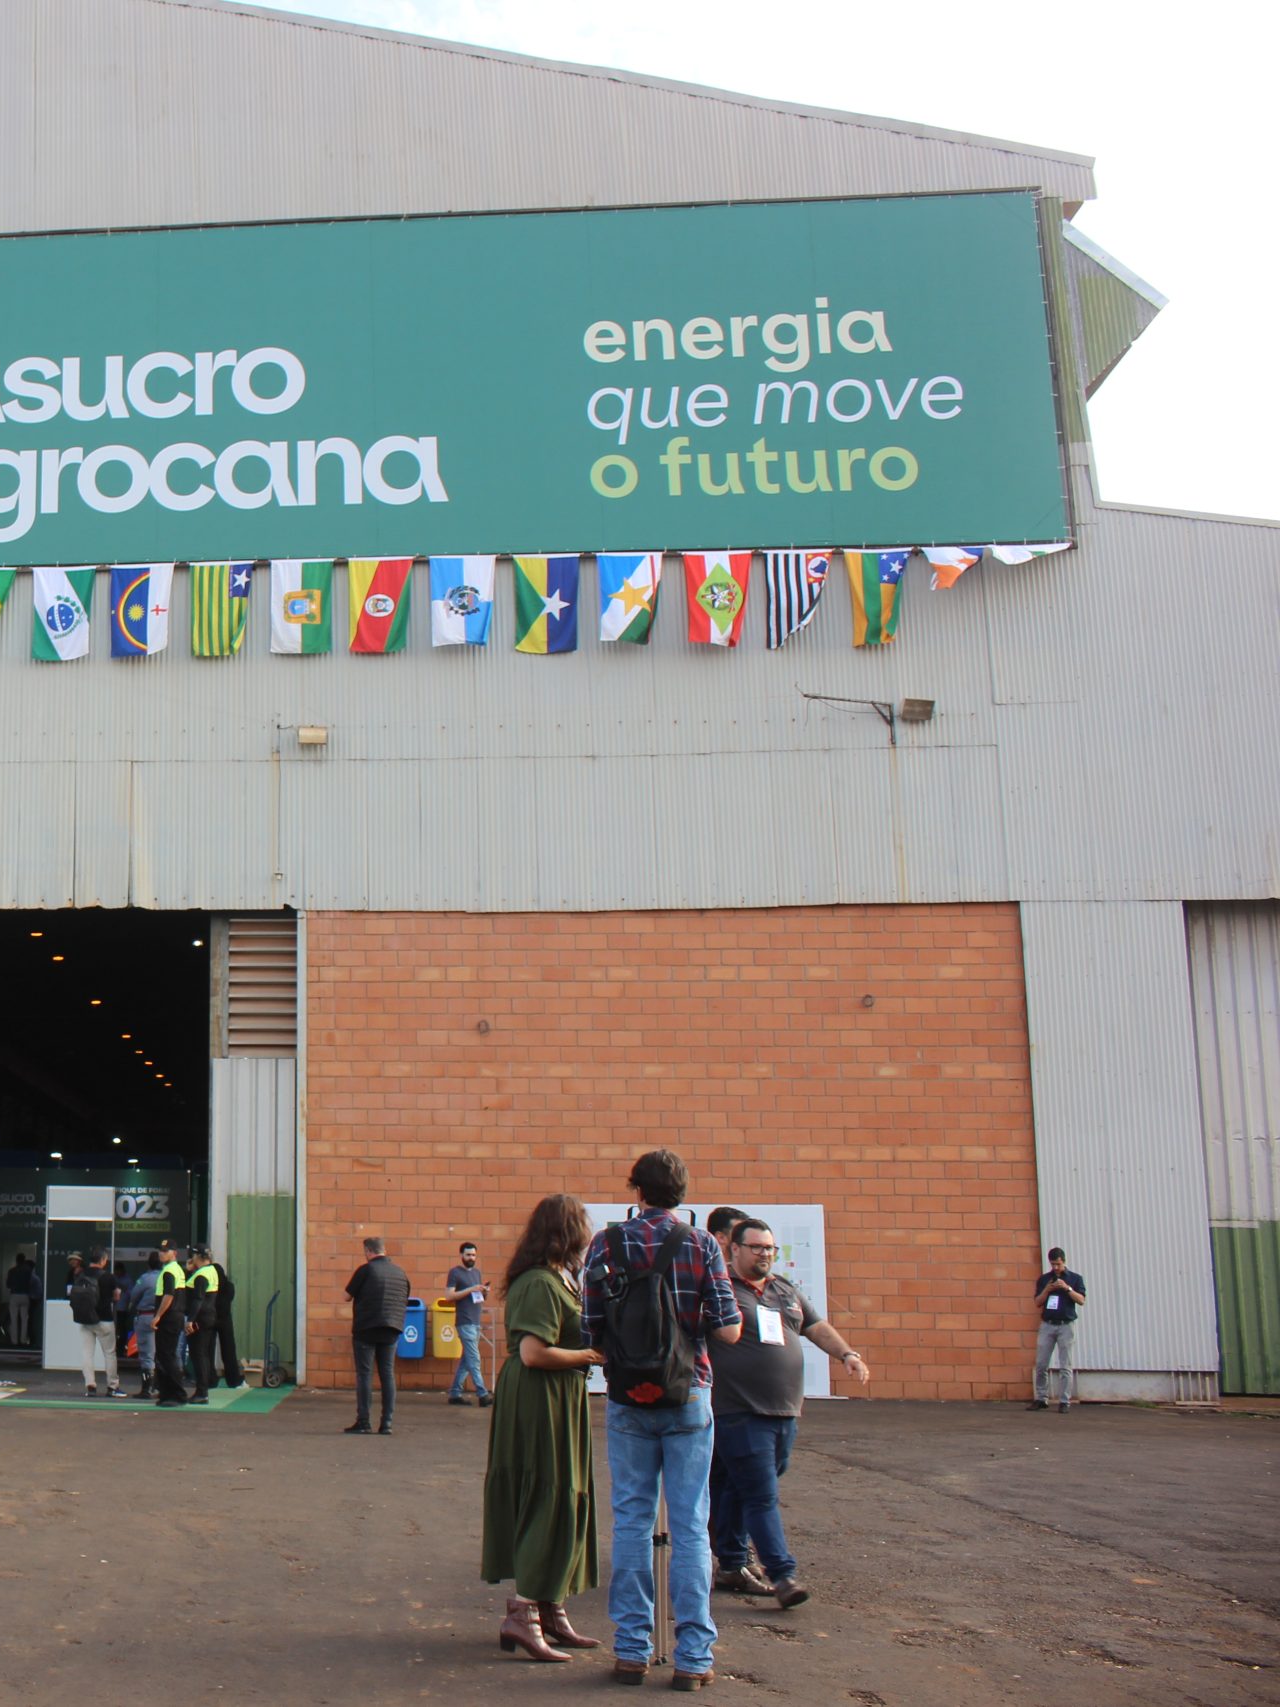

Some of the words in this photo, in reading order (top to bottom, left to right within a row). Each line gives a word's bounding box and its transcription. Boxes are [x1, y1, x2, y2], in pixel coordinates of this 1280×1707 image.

[583, 296, 894, 373] energia
[587, 384, 729, 446] que
[753, 375, 964, 425] move
[590, 454, 639, 498] o
[659, 436, 919, 496] futuro
[115, 1194, 170, 1220] 023
